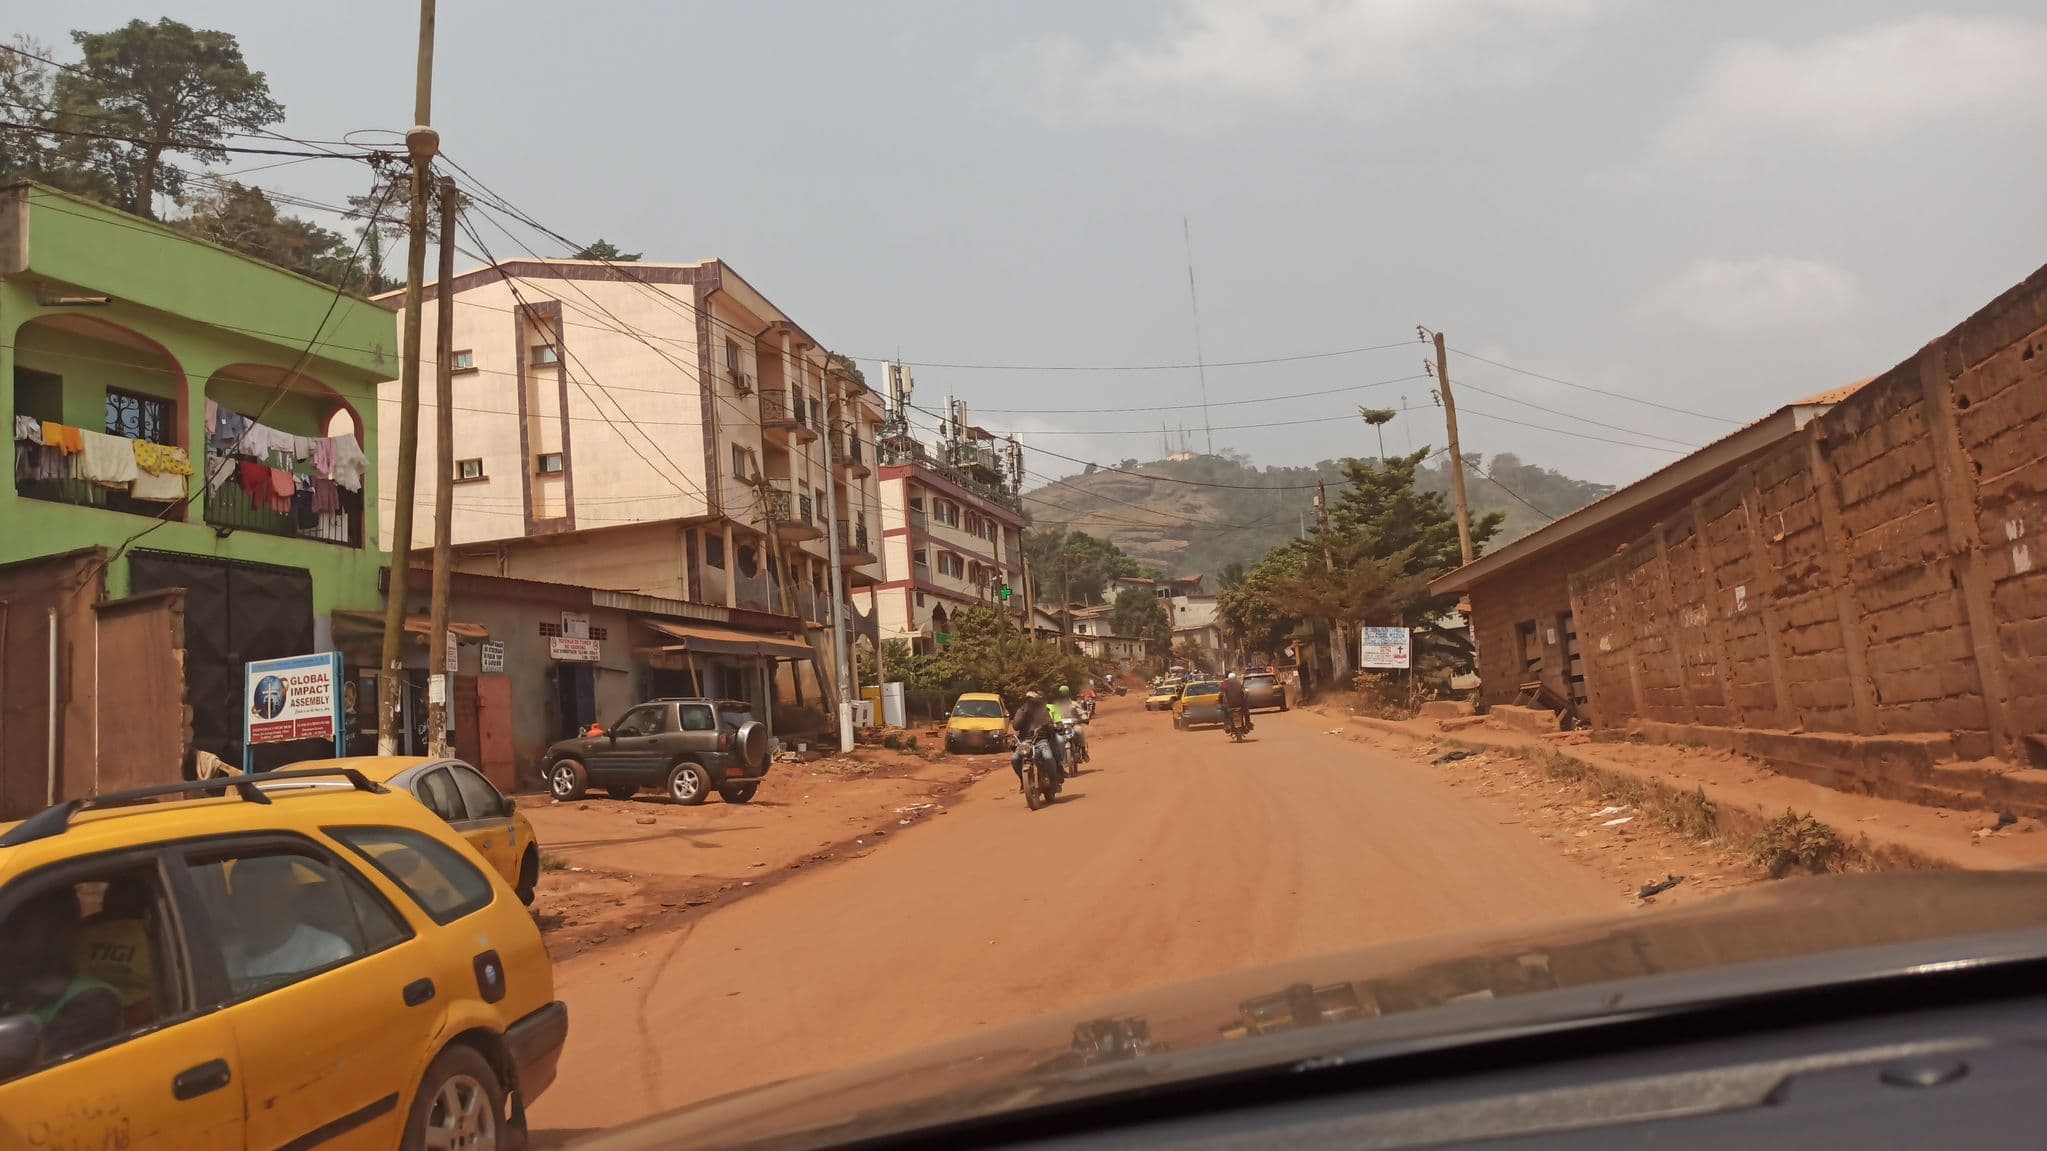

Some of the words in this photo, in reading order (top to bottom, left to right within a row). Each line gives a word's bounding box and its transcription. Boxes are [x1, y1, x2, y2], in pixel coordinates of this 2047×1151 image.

[290, 674, 330, 686] GLOBAL
[290, 684, 330, 697] IMPACT
[290, 696, 330, 708] ASSEMBLY
